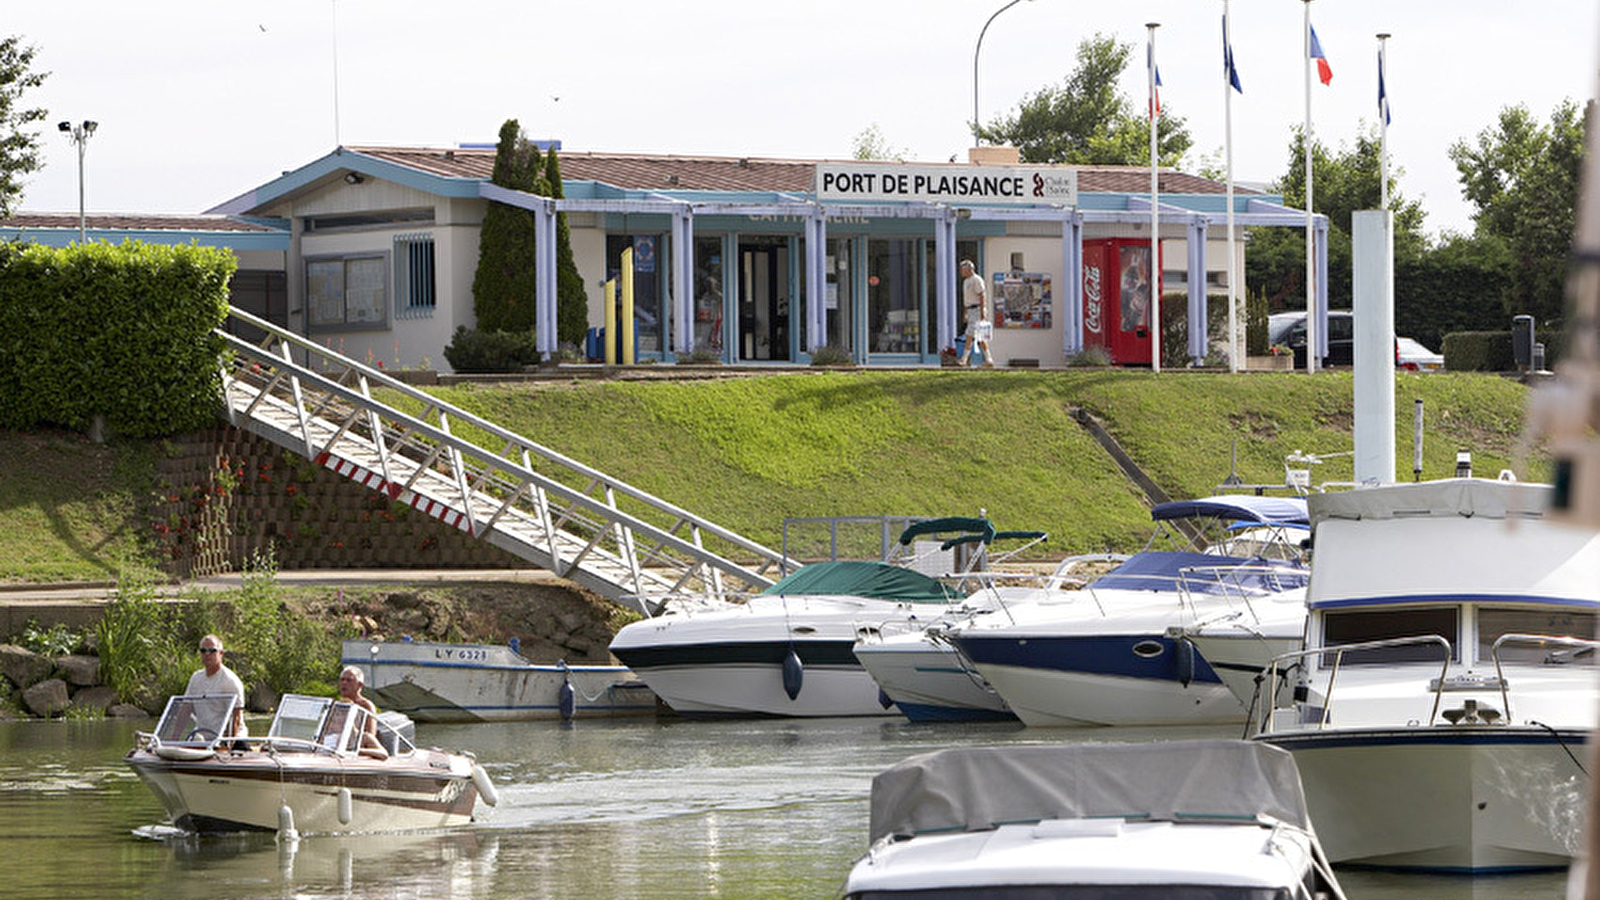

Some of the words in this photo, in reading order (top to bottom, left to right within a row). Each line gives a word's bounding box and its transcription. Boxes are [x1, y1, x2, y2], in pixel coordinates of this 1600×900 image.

[823, 172, 876, 194] PORT
[882, 174, 908, 195] DE
[914, 175, 1024, 197] PLAISANCE
